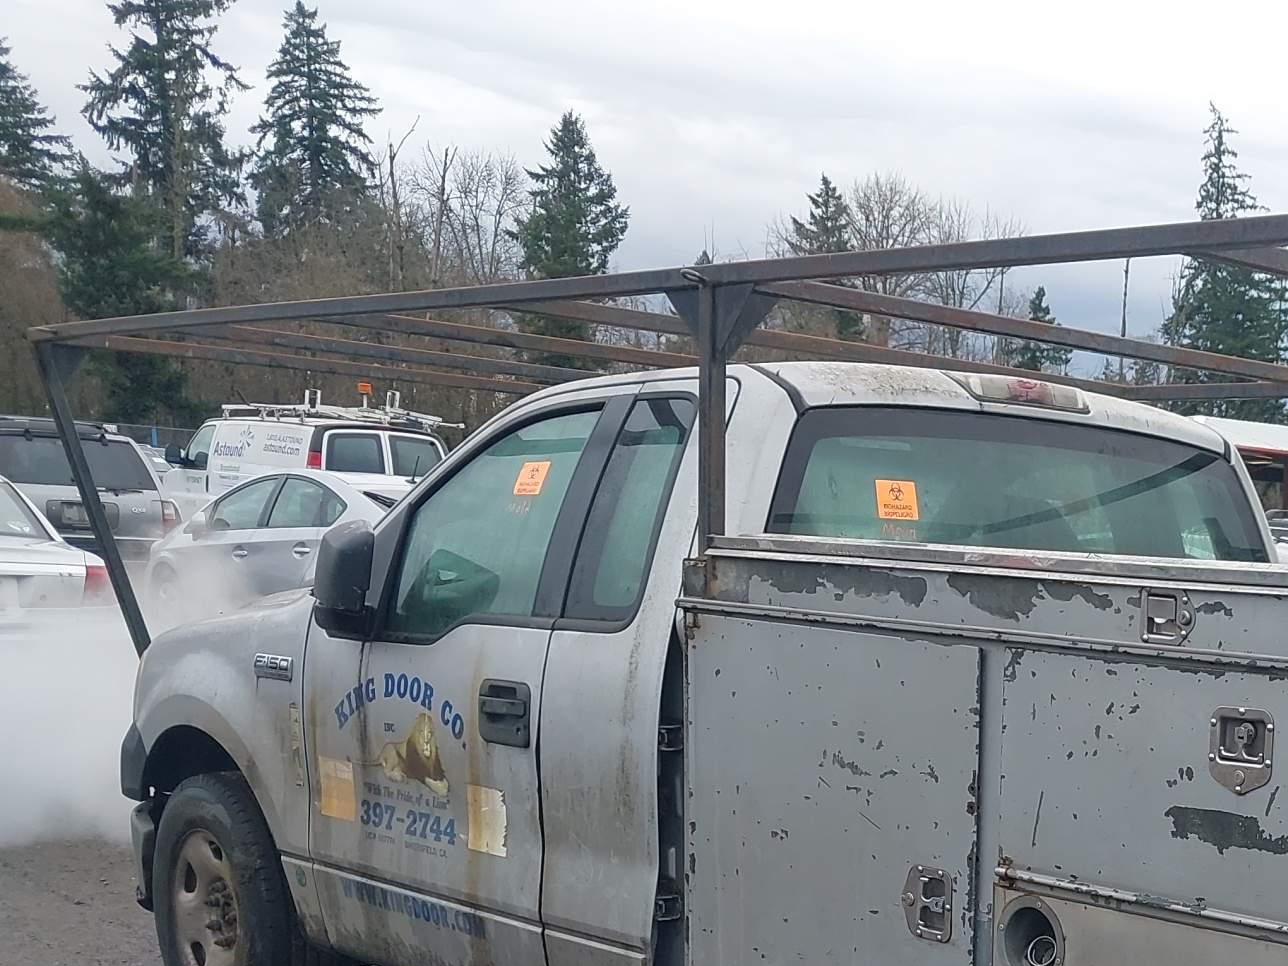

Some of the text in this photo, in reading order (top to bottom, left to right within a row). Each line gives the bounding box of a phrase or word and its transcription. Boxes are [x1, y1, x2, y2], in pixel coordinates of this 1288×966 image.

[213, 441, 243, 457] Astound
[263, 443, 300, 456] astound.com
[334, 672, 466, 751] KING DOOR CO.
[360, 799, 457, 847] 397-2744
[342, 877, 486, 939] WWW.KINGDOOR.COM
